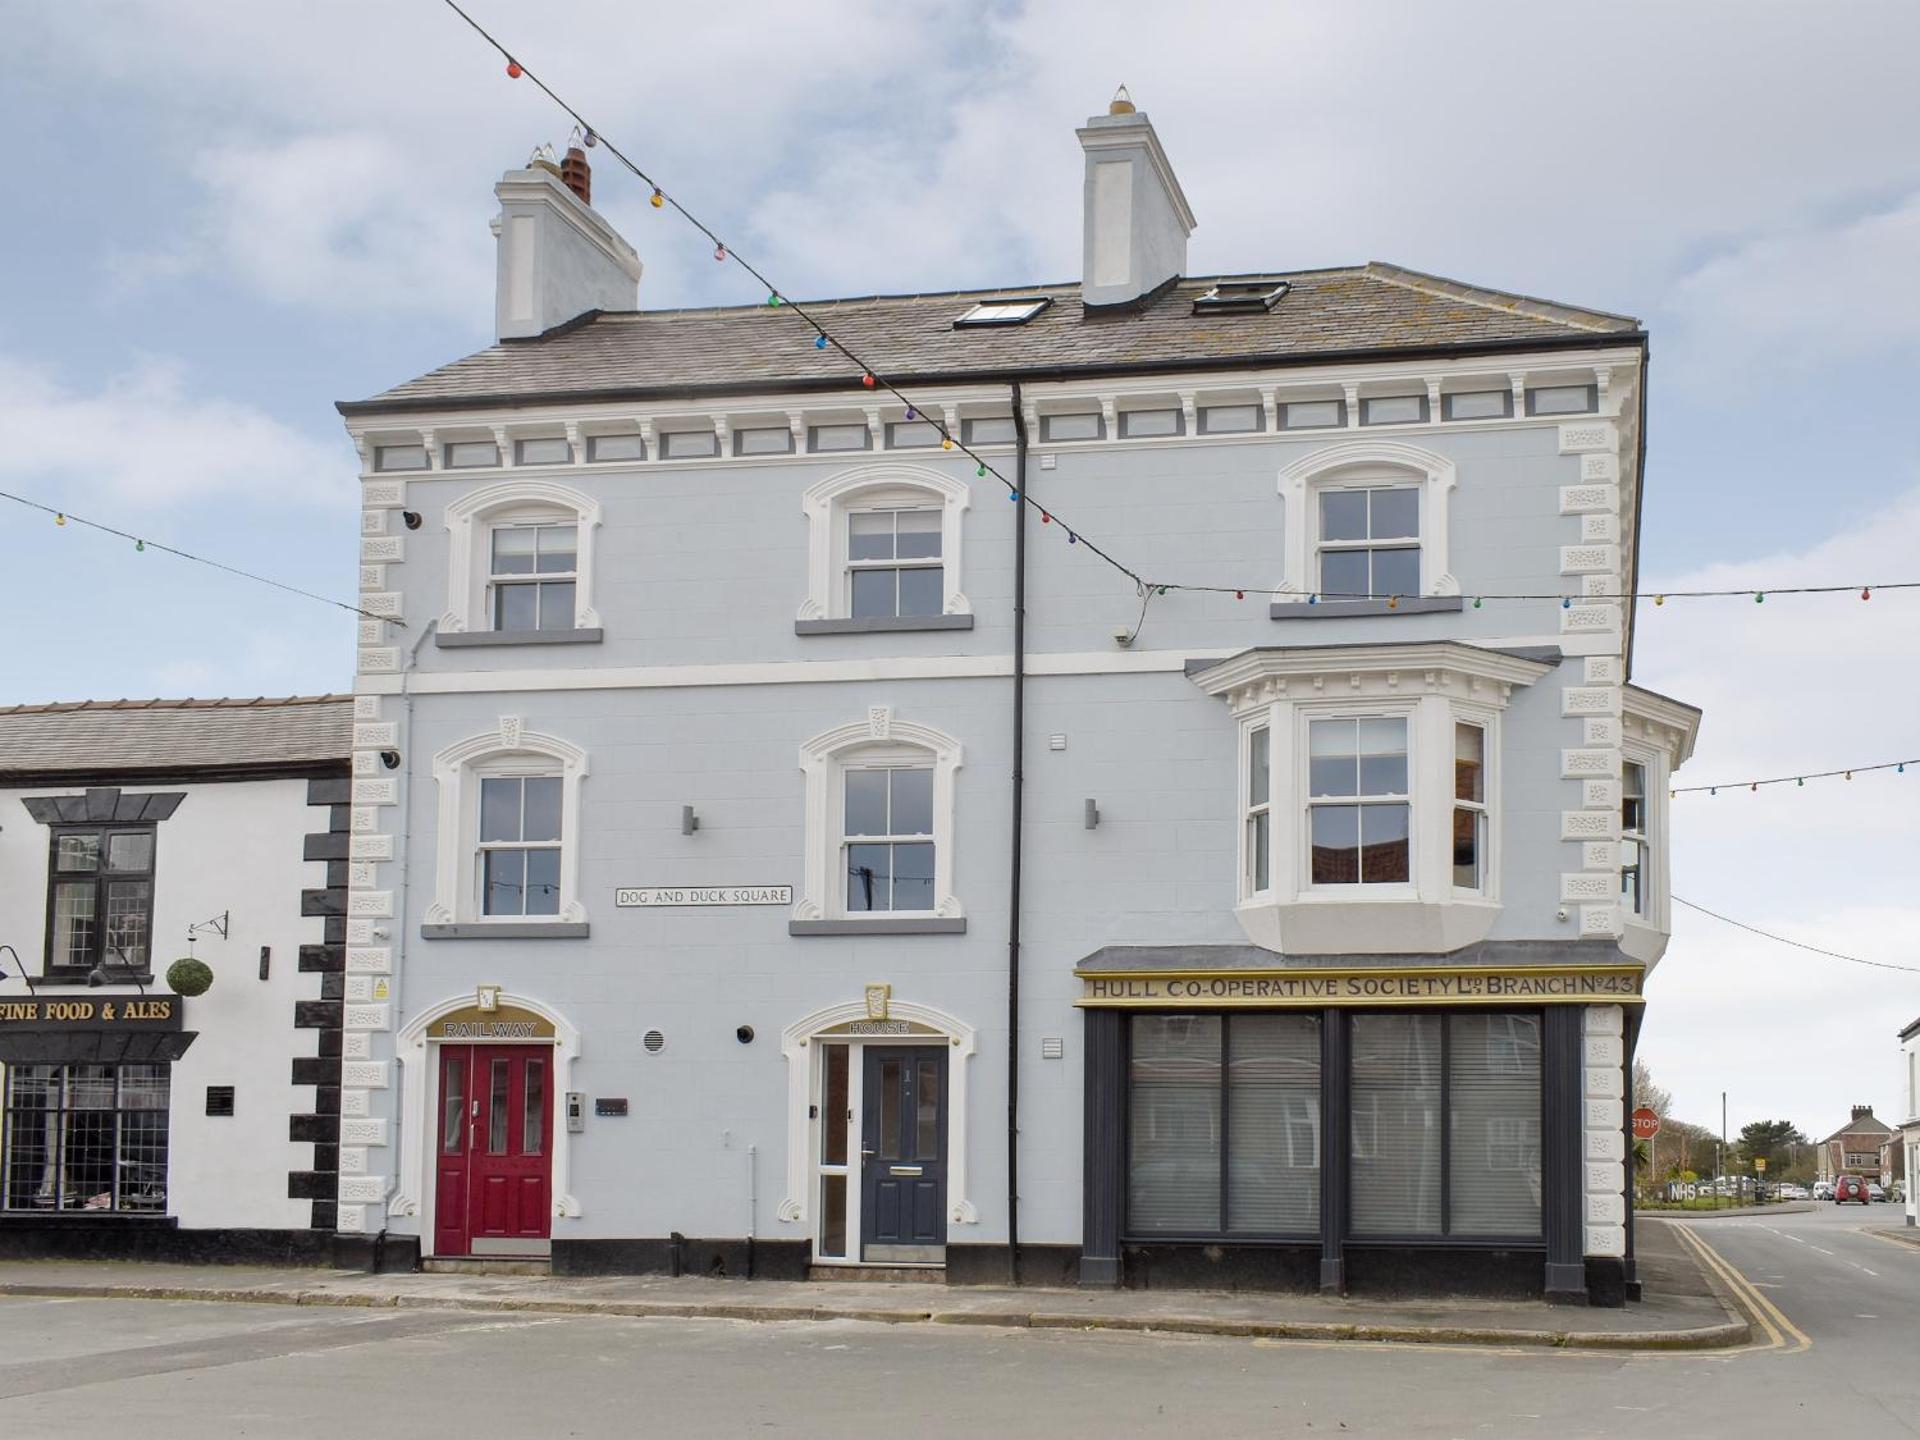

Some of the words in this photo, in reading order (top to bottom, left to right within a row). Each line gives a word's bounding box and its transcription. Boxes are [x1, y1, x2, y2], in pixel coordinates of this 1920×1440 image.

[620, 891, 648, 903] DOG
[655, 891, 684, 902] AND
[690, 890, 727, 902] DUCK
[734, 889, 787, 902] SQUARE
[1093, 980, 1158, 998] HULL
[1167, 979, 1338, 997] CO-OPERATIVE
[1347, 977, 1454, 996] SOCIETY
[1487, 976, 1577, 994] BRANCH
[46, 1002, 94, 1020] FOOD
[102, 1002, 116, 1020] &
[123, 1002, 171, 1019] ALES
[443, 1022, 537, 1037] RAILWAY
[850, 1022, 910, 1034] HOUSE
[1632, 1119, 1657, 1128] STOP
[1671, 1183, 1696, 1201] NHS
